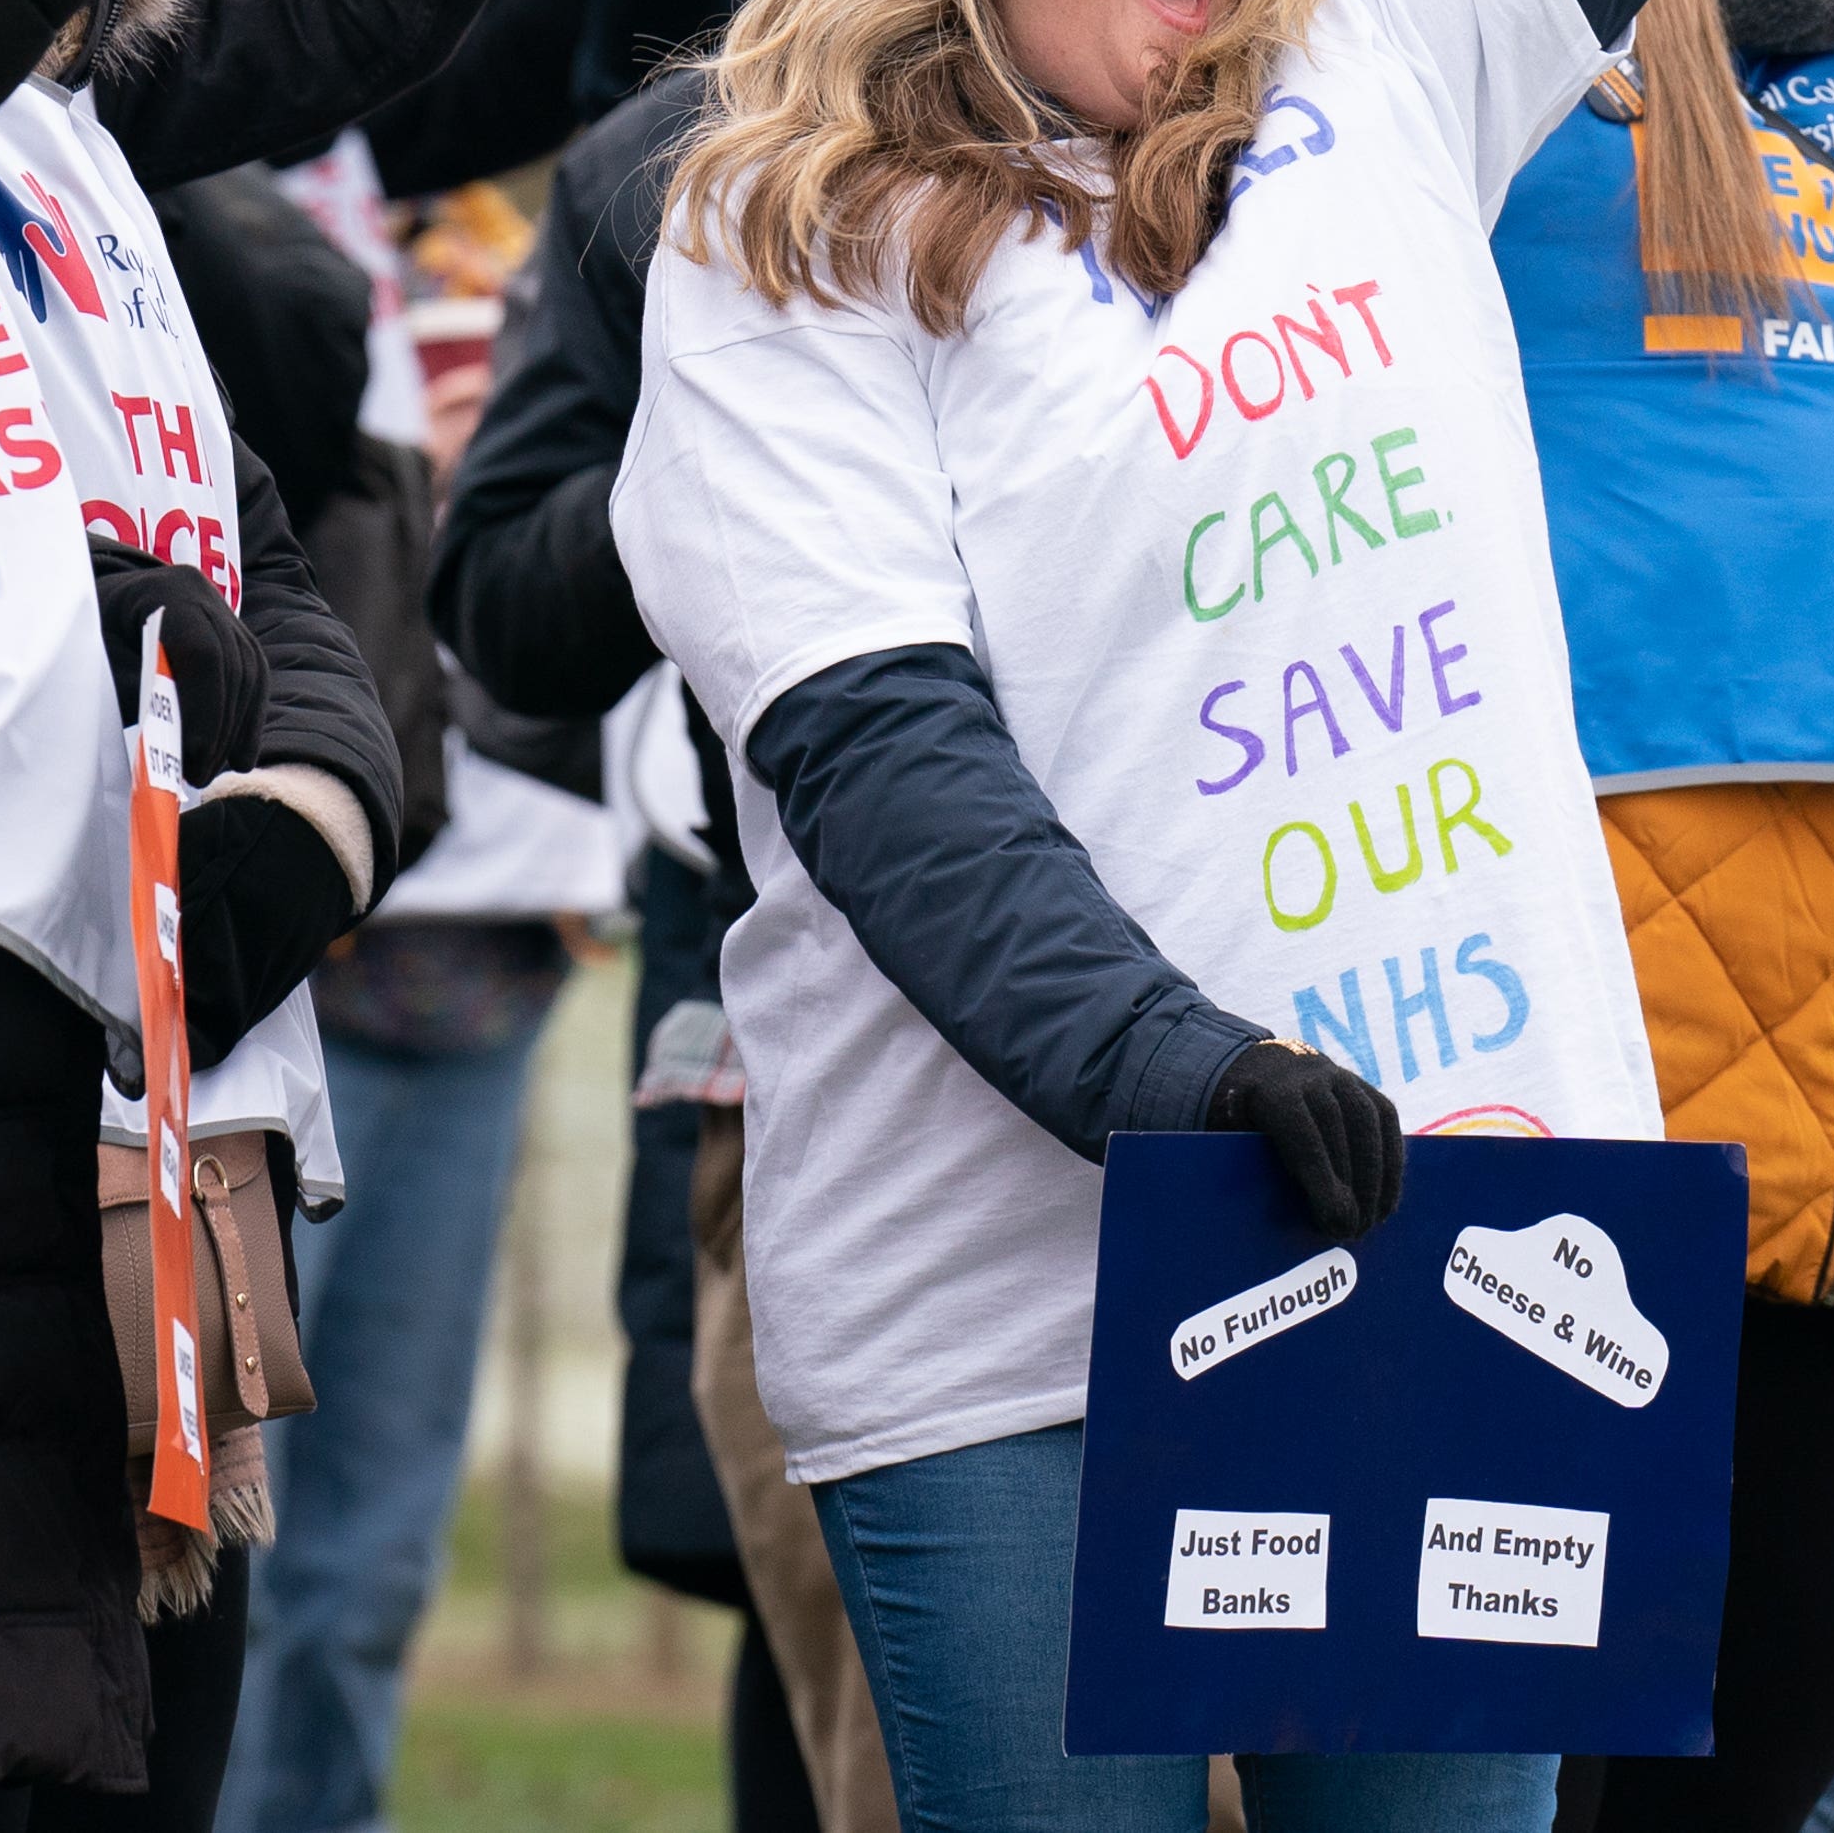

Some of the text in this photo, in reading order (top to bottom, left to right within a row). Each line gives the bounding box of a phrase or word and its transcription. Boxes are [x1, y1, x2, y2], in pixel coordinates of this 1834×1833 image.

[1196, 599, 1481, 796] SAVE
[1263, 757, 1514, 933] OUR
[1292, 932, 1531, 1090] NHS
[1551, 1237, 1595, 1279] No
[1179, 1264, 1349, 1368] No Furlough
[1449, 1246, 1655, 1392] Cheese & Wine
[1179, 1528, 1323, 1558] Just Food
[1427, 1523, 1596, 1570] And Empty
[1201, 1588, 1292, 1616] Banks
[1447, 1583, 1560, 1618] Thanks
